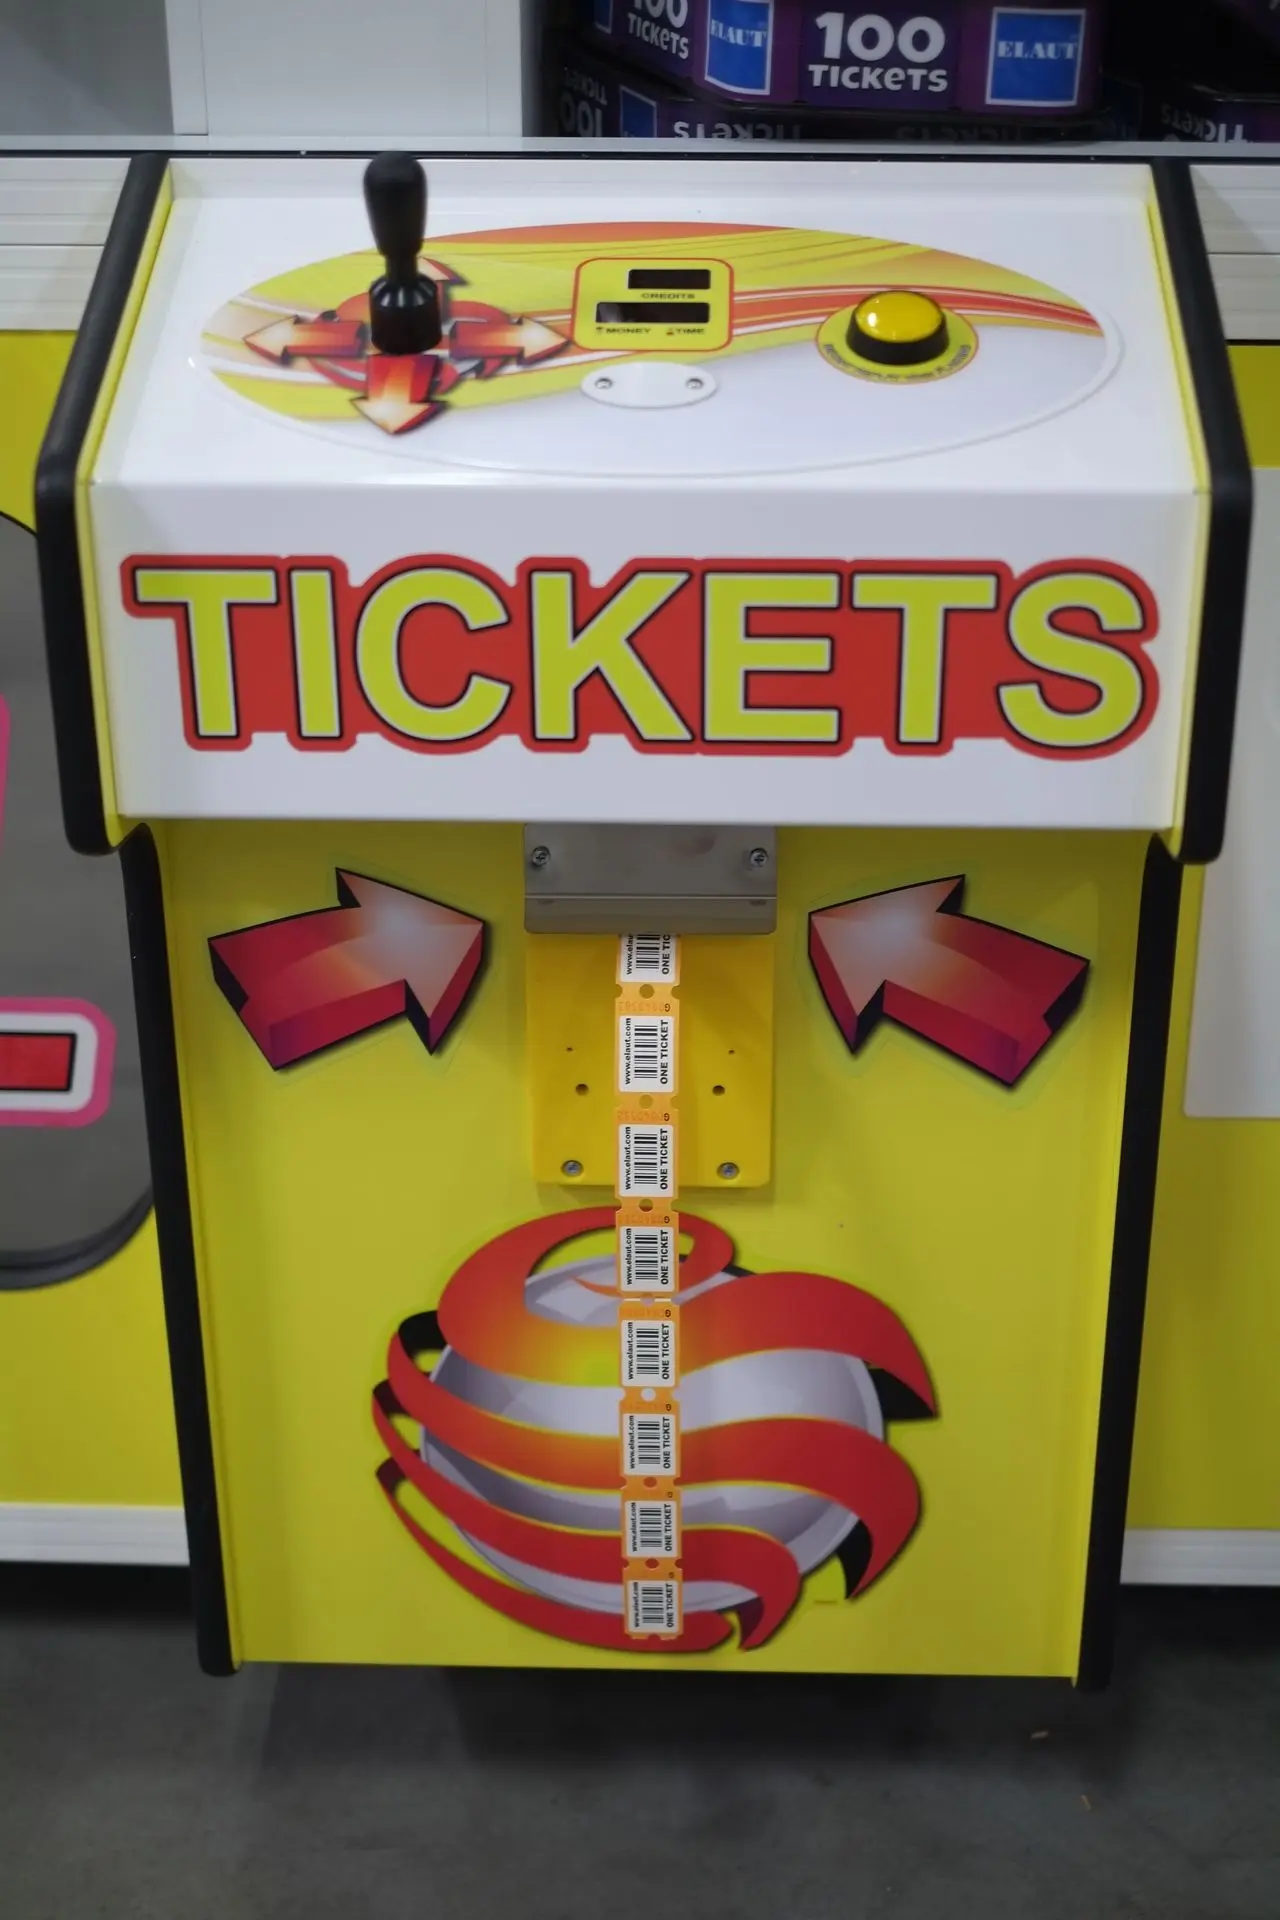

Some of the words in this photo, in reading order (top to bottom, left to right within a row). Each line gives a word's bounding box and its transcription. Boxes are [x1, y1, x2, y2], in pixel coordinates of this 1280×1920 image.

[711, 19, 767, 48] ELAUT
[815, 11, 946, 63] 100
[997, 40, 1079, 60] ELAUT
[134, 566, 1146, 749] TICKETS
[662, 953, 670, 975] ONE
[624, 1018, 632, 1085] www.elaut.com
[660, 1020, 669, 1059] TICKET
[660, 1062, 669, 1085] ONE
[624, 1126, 632, 1190] www.elaut.com
[660, 1128, 669, 1165] TICKET
[660, 1168, 669, 1190] ONE
[661, 1230, 669, 1261] TICKET
[661, 1265, 669, 1285] ONE
[662, 1324, 670, 1357] TICKET
[662, 1359, 670, 1380] ONE
[663, 1451, 671, 1469] ONE
[664, 1535, 672, 1552] ONE
